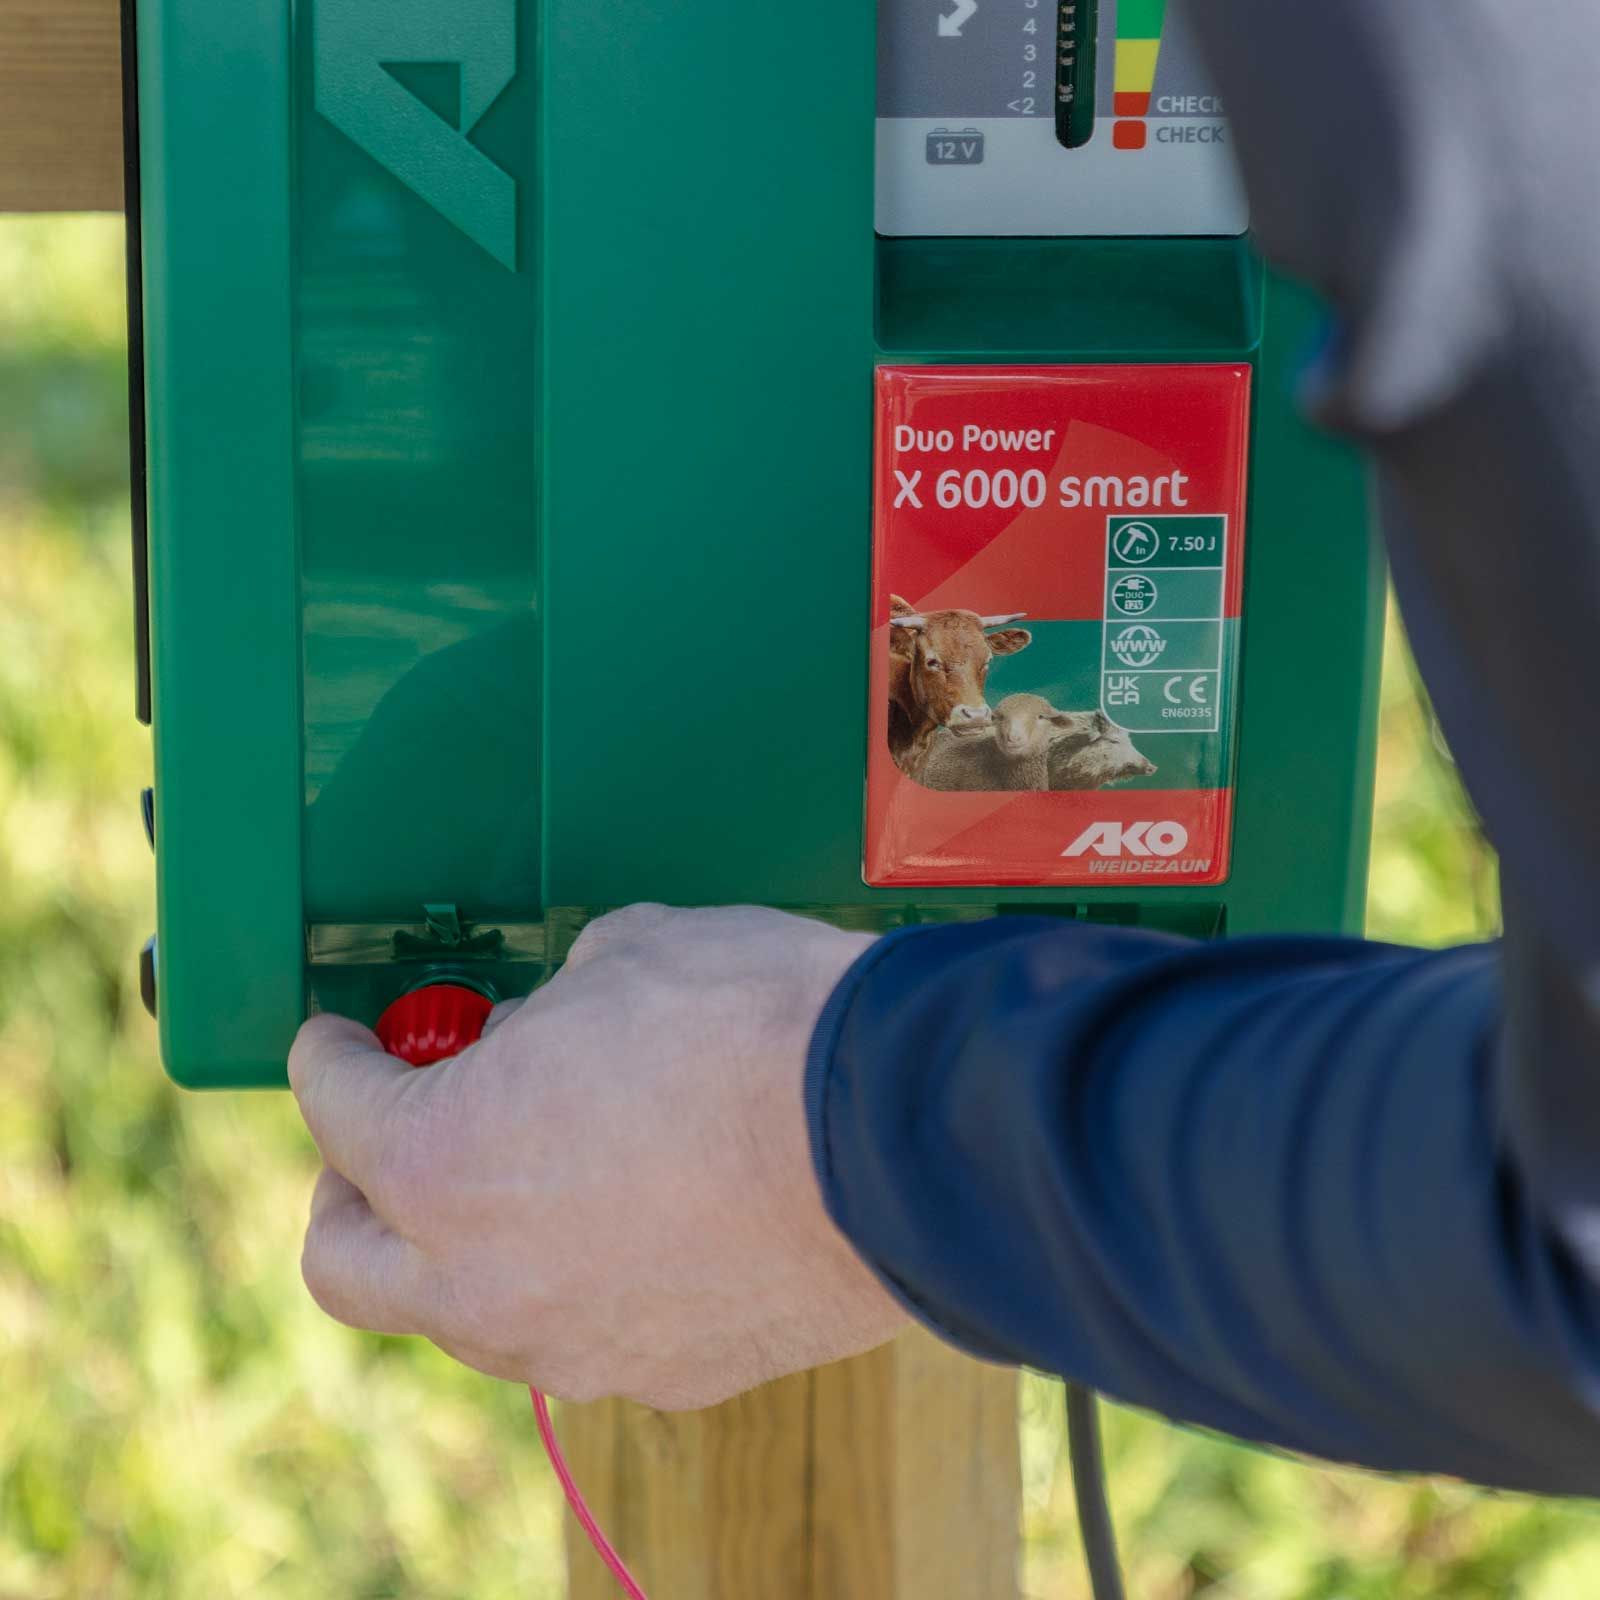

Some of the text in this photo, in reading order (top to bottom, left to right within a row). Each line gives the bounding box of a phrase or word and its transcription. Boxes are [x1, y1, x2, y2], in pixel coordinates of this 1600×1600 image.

[1022, 18, 1038, 35] 4
[1023, 43, 1037, 61] 3
[1023, 71, 1036, 88] 2
[1006, 97, 1035, 115] <2
[1156, 95, 1225, 113] CHECK
[1155, 125, 1225, 144] CHECK
[935, 142, 977, 159] 12 V
[894, 424, 1056, 452] Duo Power
[893, 469, 1189, 509] X 6000 smart
[1168, 536, 1216, 552] 7.50 J
[1125, 591, 1145, 600] DUO
[1107, 675, 1140, 691] UK
[1163, 675, 1208, 704] CE
[1107, 690, 1140, 705] CA
[1161, 707, 1212, 718] EN60335
[1060, 820, 1189, 857] AKO
[1088, 859, 1211, 874] WEIDEZAUN
